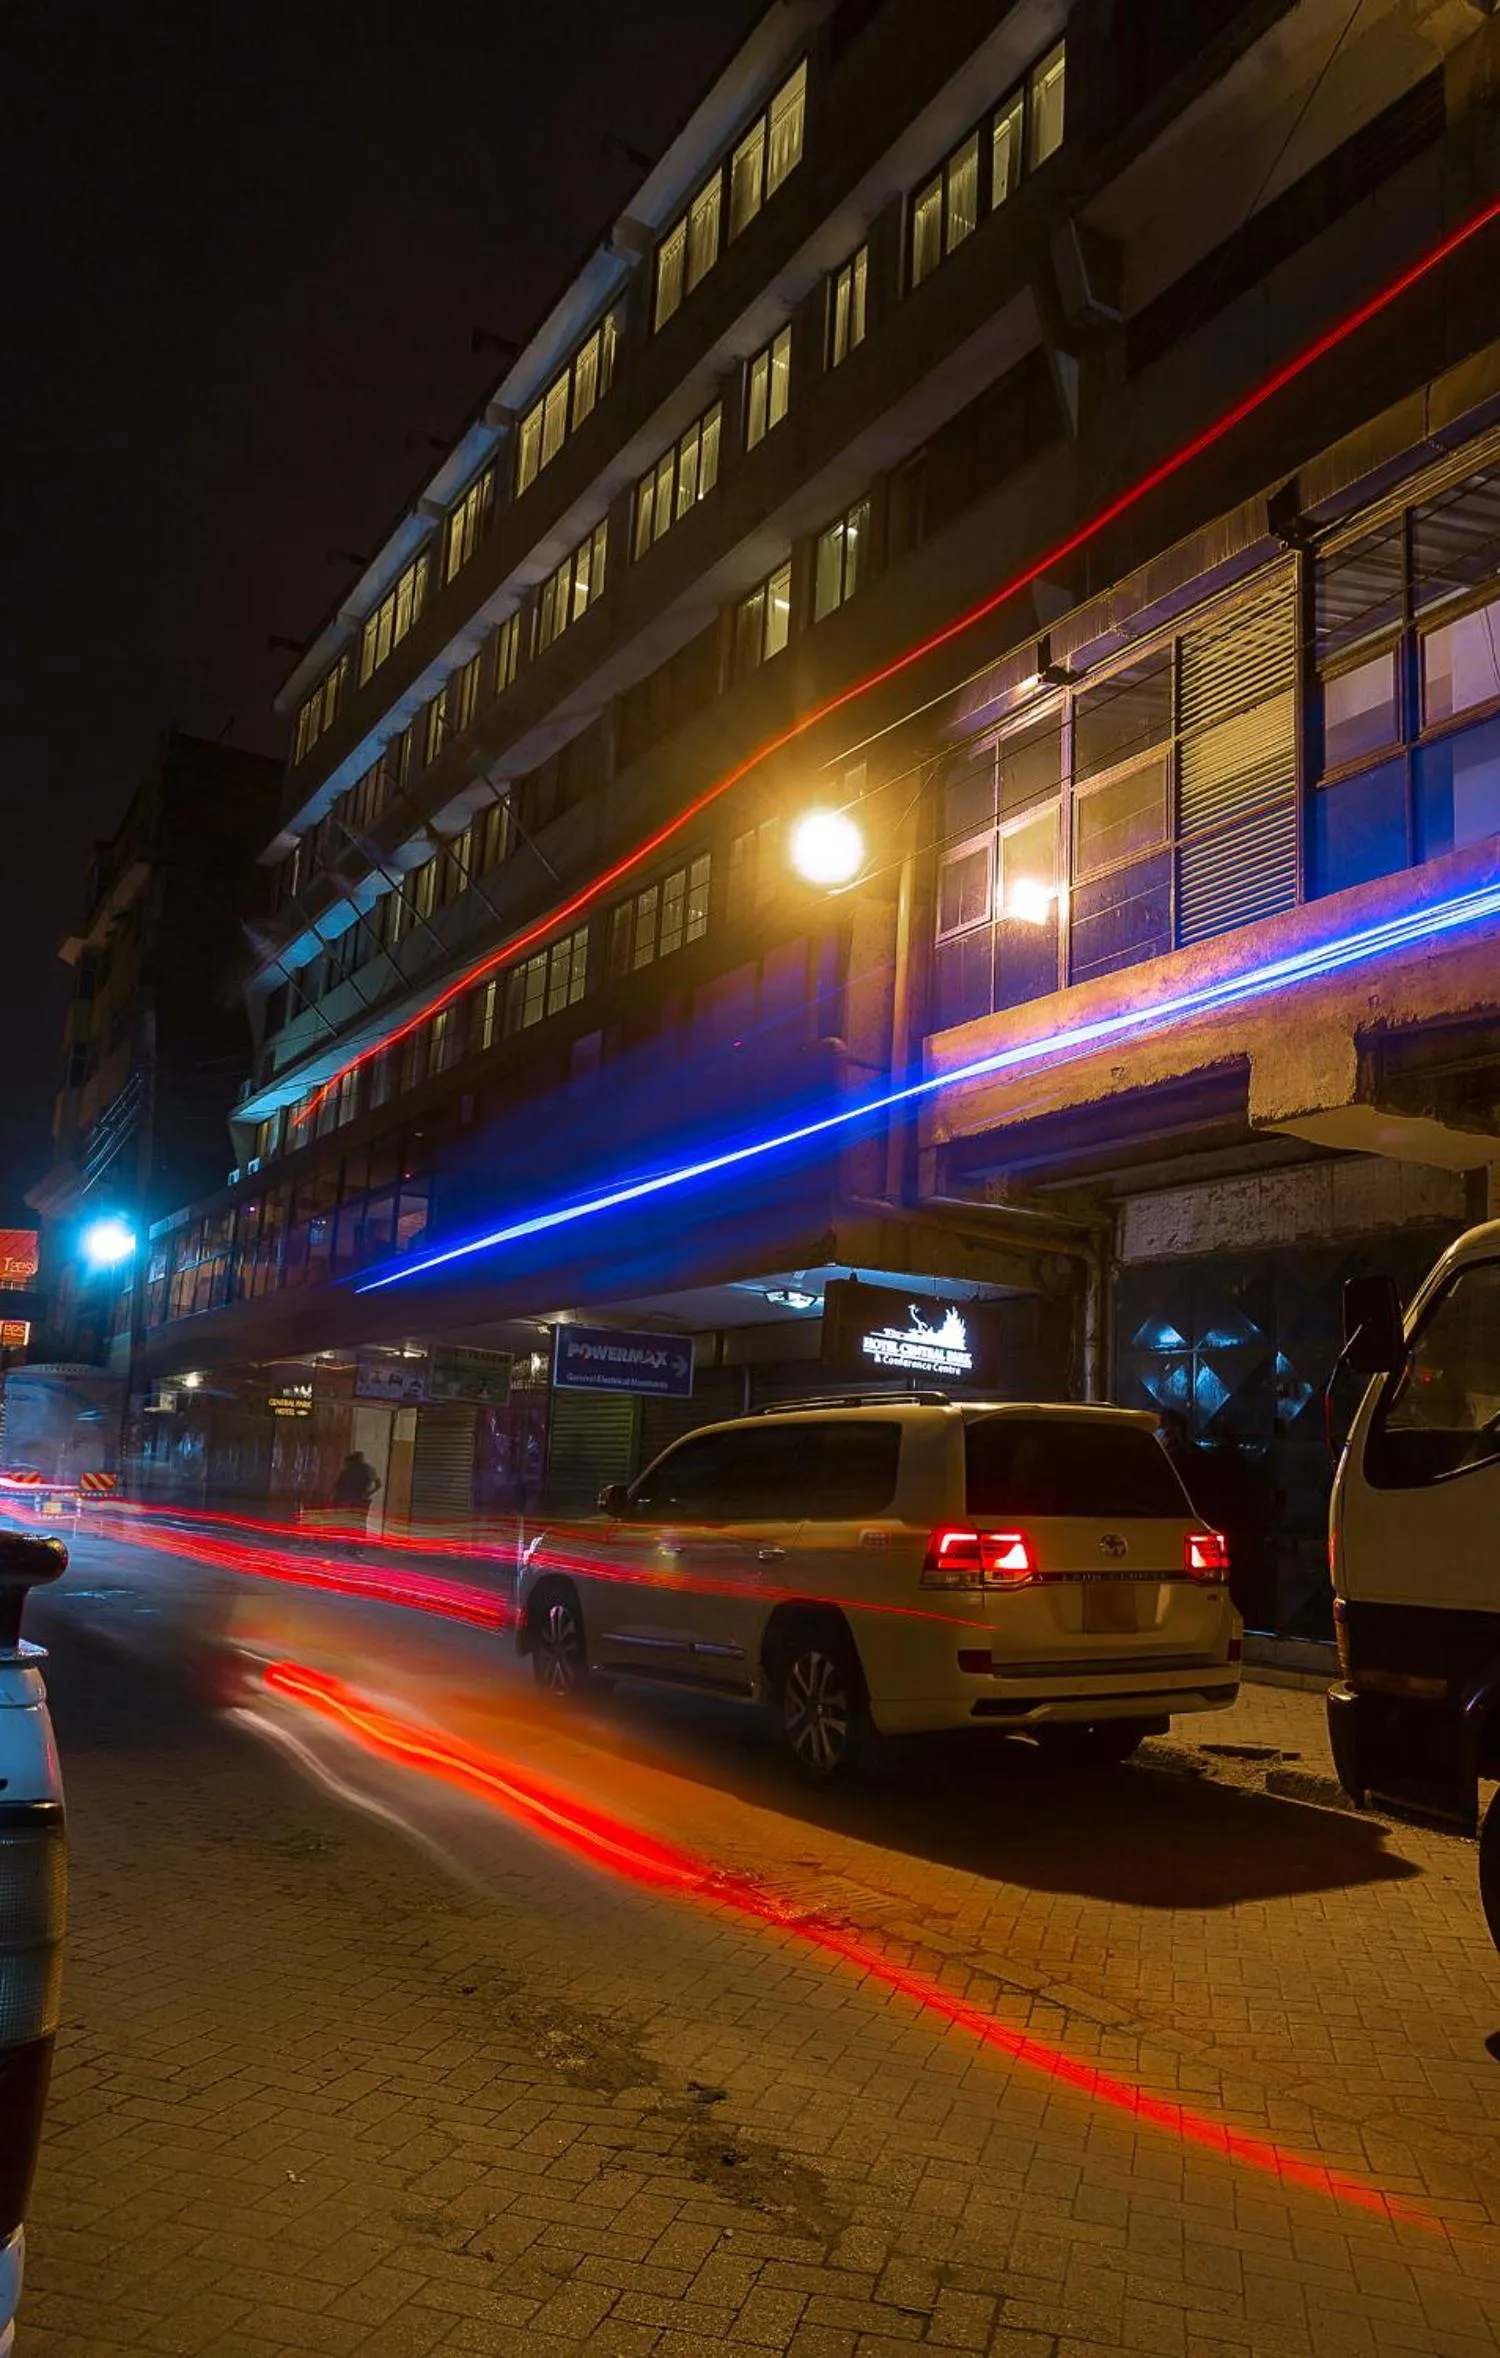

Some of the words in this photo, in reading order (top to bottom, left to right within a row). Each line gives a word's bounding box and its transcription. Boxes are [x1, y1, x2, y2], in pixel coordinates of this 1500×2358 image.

[566, 1342, 668, 1368] POWERMAX
[863, 1336, 899, 1353] HOTEL
[900, 1342, 946, 1360] CENTRAL
[947, 1350, 972, 1367] PARK
[883, 1355, 932, 1371] Conference
[933, 1362, 961, 1375] Centre
